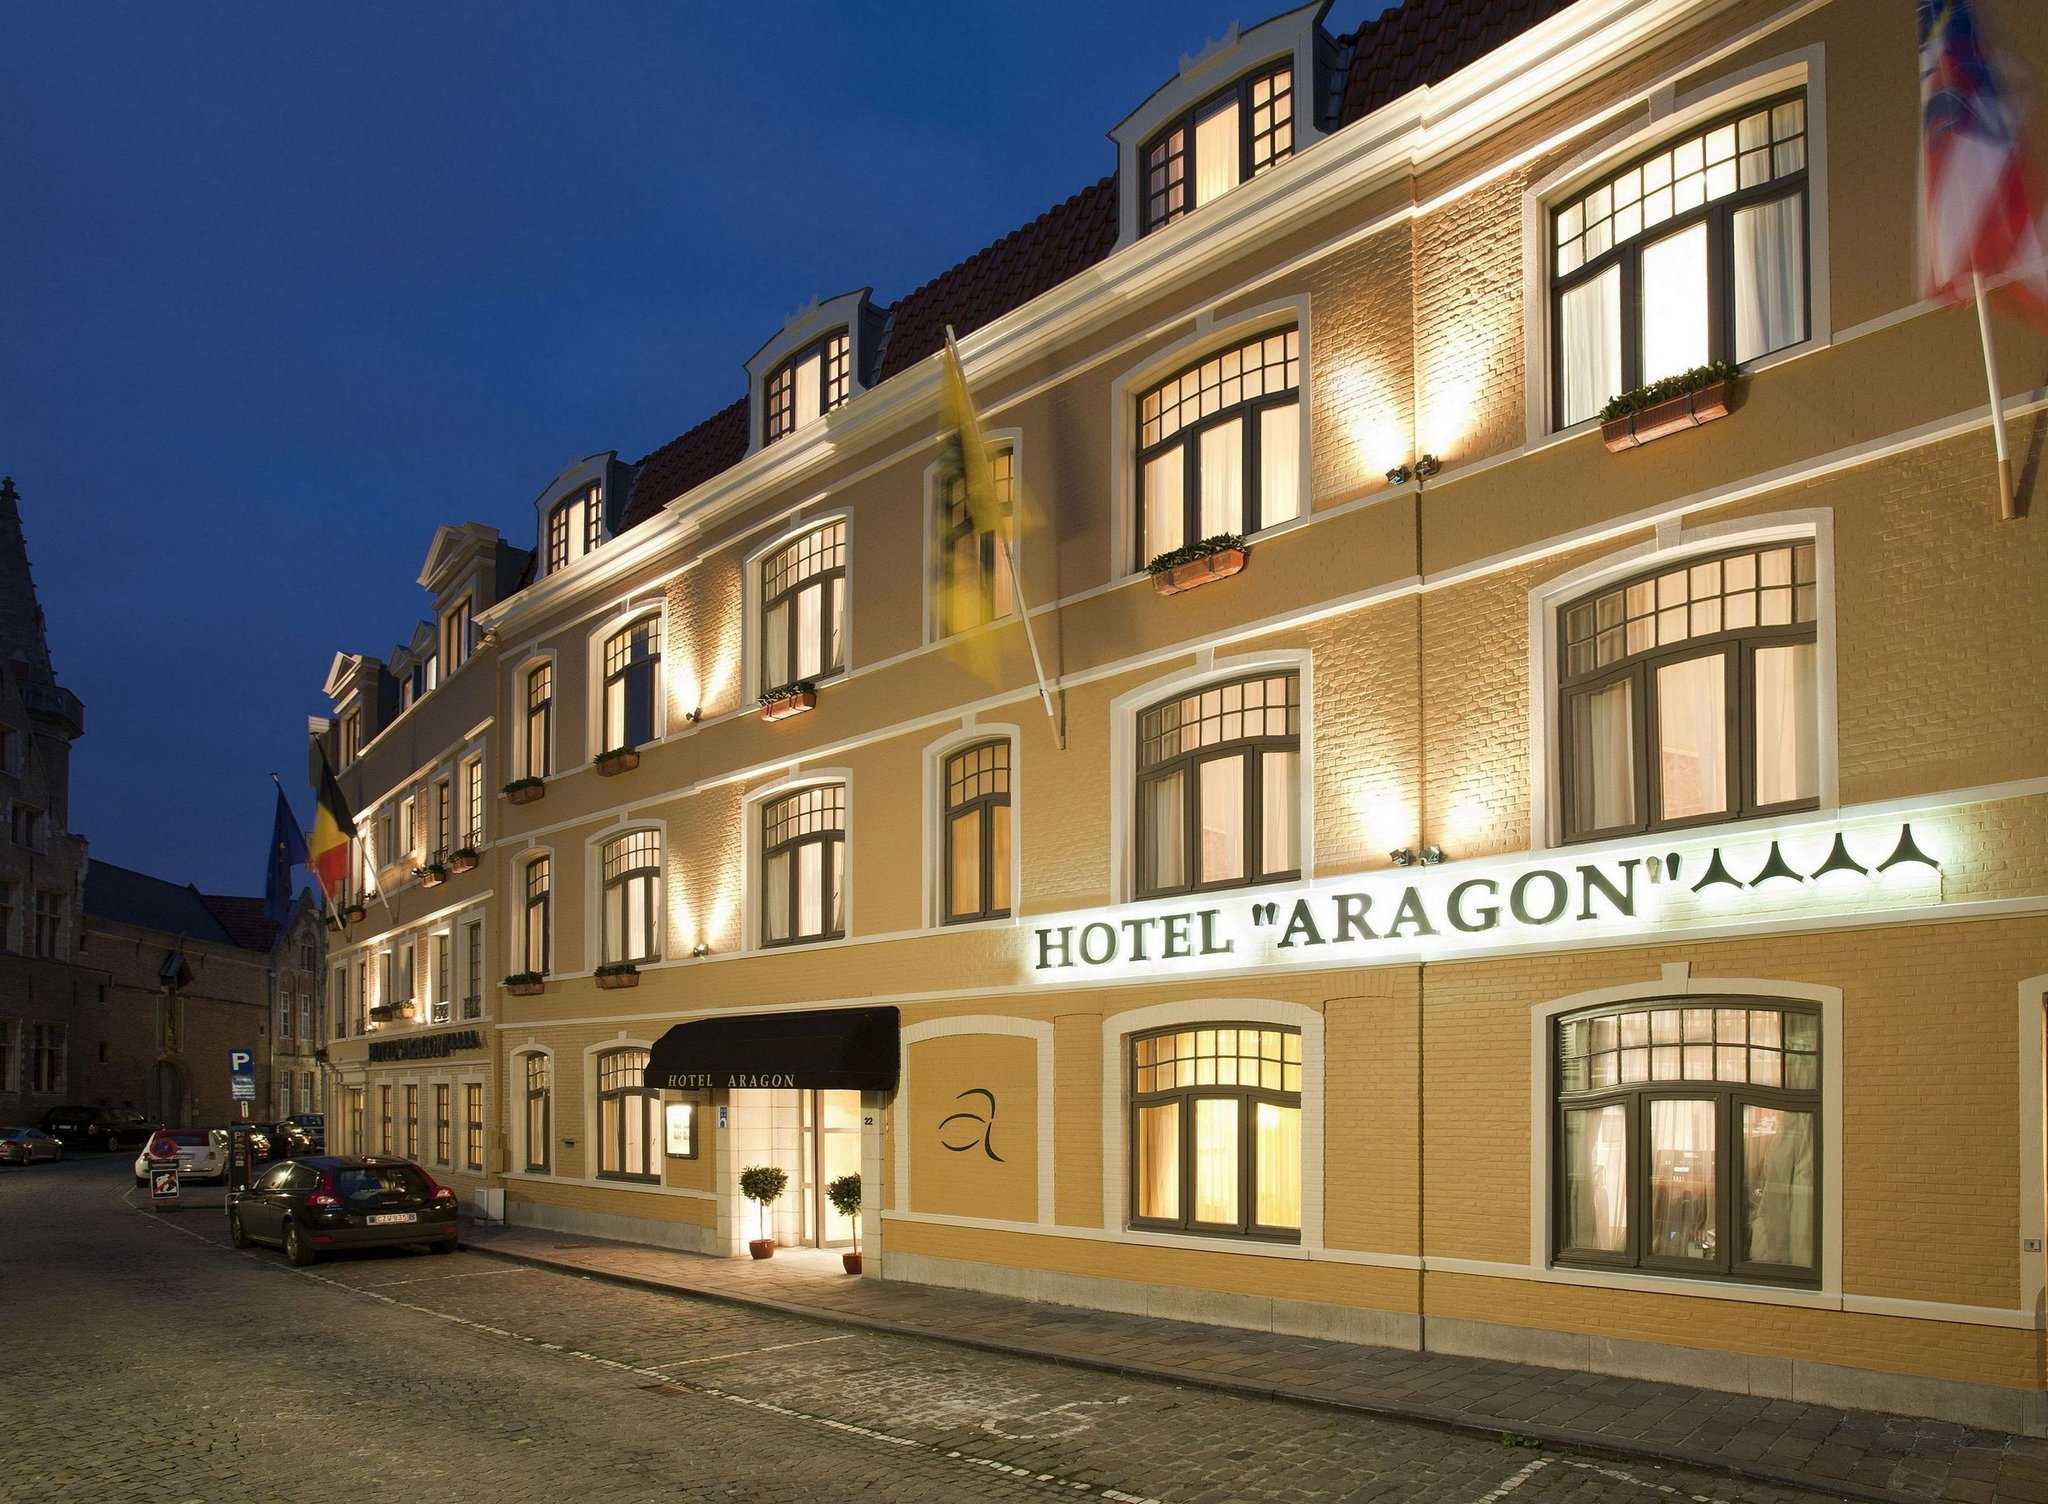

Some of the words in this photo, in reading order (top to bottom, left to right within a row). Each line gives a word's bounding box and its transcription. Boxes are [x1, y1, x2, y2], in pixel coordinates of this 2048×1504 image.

[1035, 909, 1234, 970] HOTEL
[231, 1052, 250, 1071] P
[668, 1074, 713, 1087] HOTEL
[728, 1073, 795, 1088] ARAGON
[864, 1116, 873, 1126] 22
